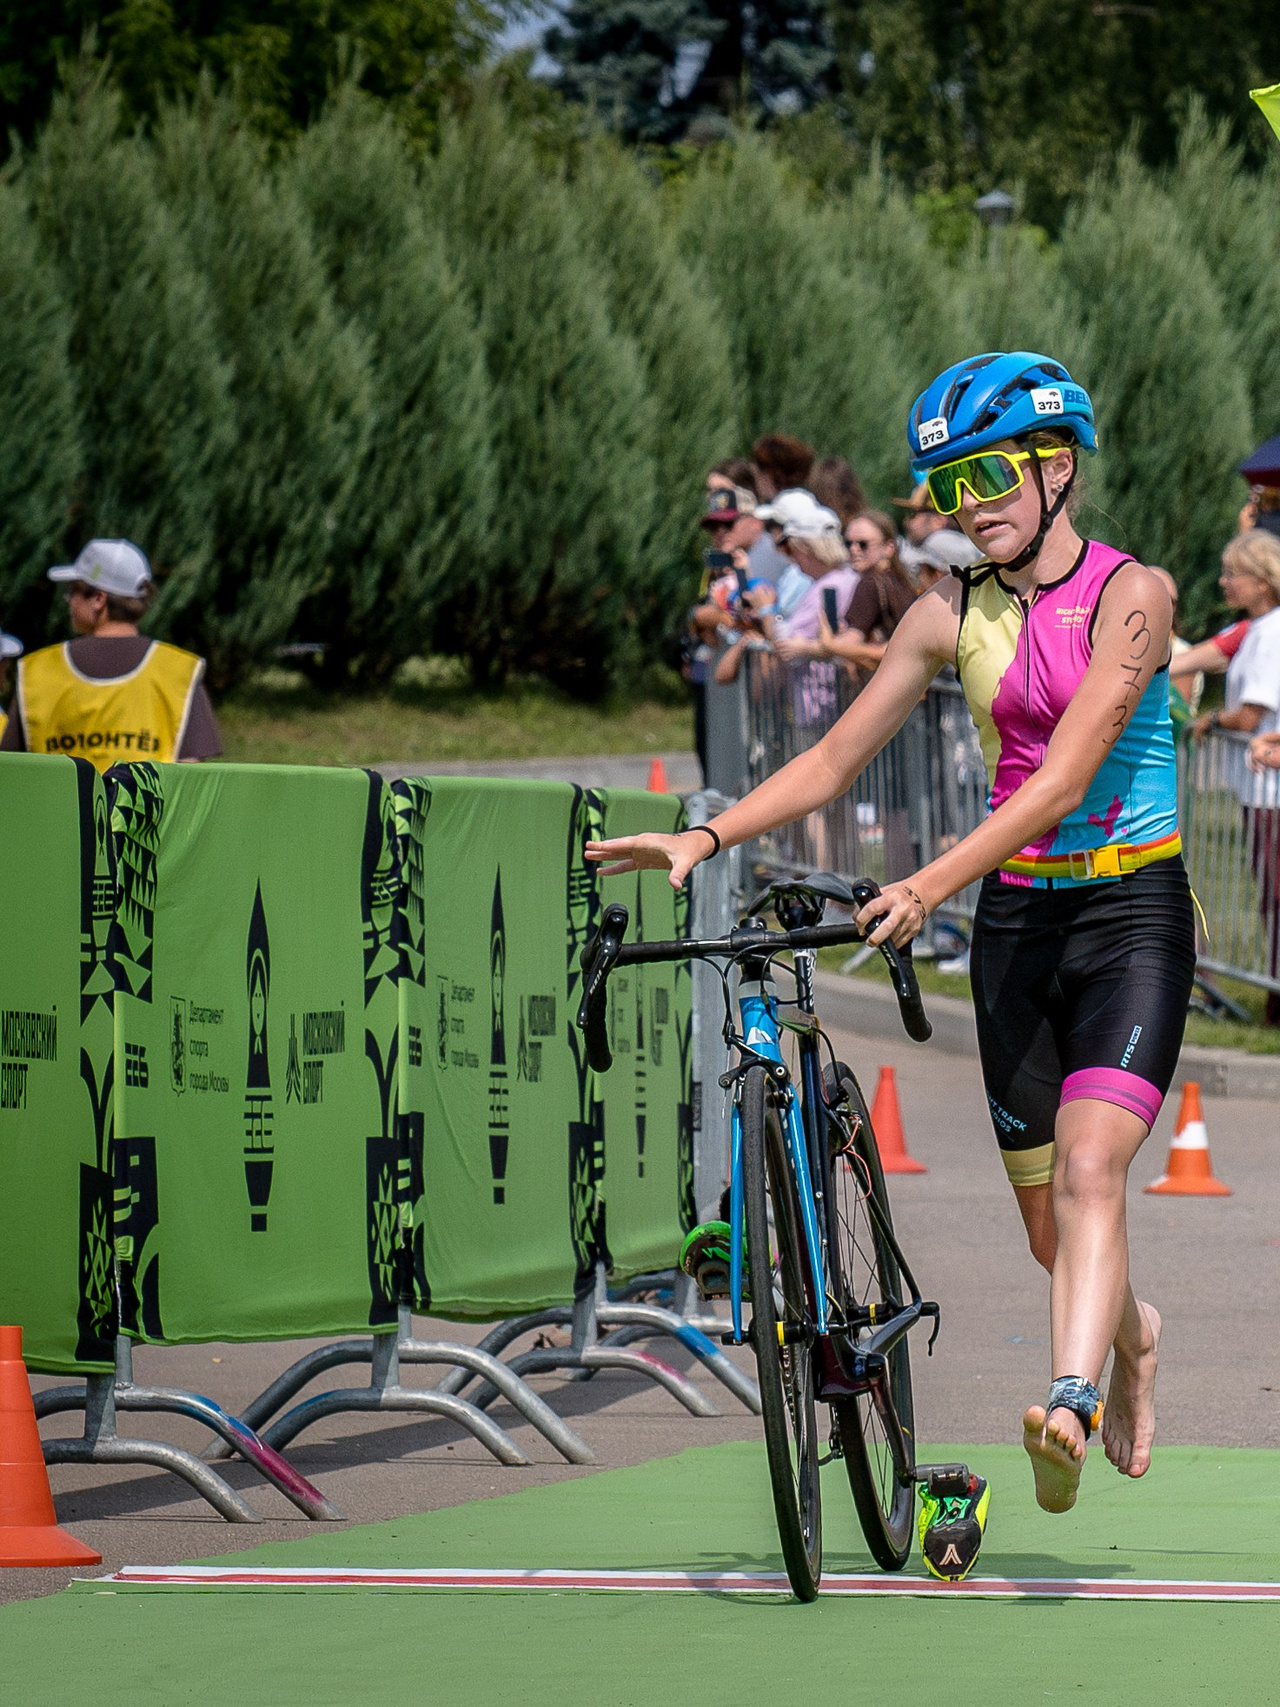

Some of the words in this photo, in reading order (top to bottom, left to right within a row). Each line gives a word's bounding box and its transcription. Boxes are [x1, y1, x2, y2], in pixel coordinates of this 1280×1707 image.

[1037, 401, 1060, 411] 373
[921, 430, 945, 446] 373
[1102, 610, 1151, 745] 373
[1, 1004, 58, 1062] МОСКОВСКИЙ
[1120, 1043, 1135, 1068] RTS
[1, 1062, 28, 1110] СПОРТ
[991, 1109, 1012, 1133] DIOS
[997, 1106, 1027, 1132] TRACK
